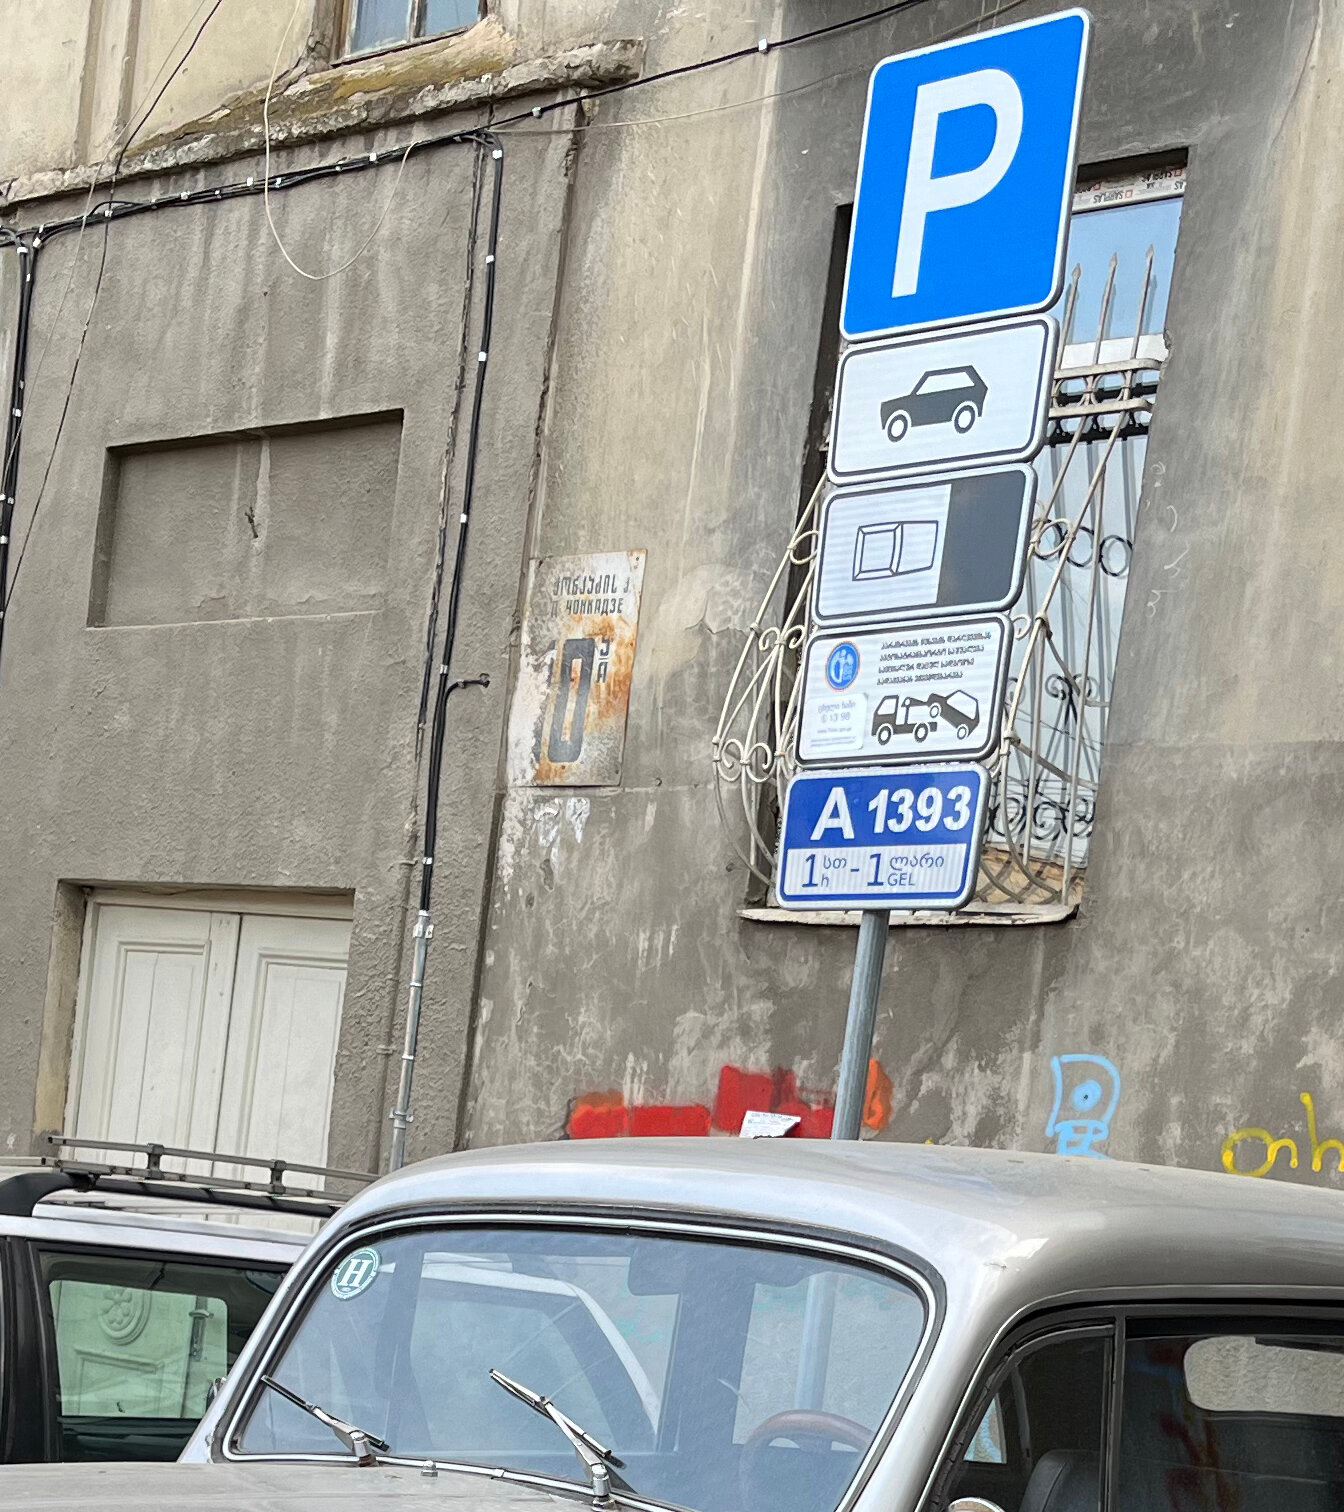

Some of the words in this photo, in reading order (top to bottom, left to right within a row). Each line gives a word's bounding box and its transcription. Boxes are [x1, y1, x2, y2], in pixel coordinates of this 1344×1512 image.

[891, 68, 1025, 298] P
[809, 786, 855, 841] A
[867, 785, 971, 834] 1393
[801, 853, 819, 888] 1
[867, 852, 884, 887] 1
[889, 852, 945, 872] ლარი
[887, 872, 916, 887] GEL
[337, 1258, 374, 1288] H
